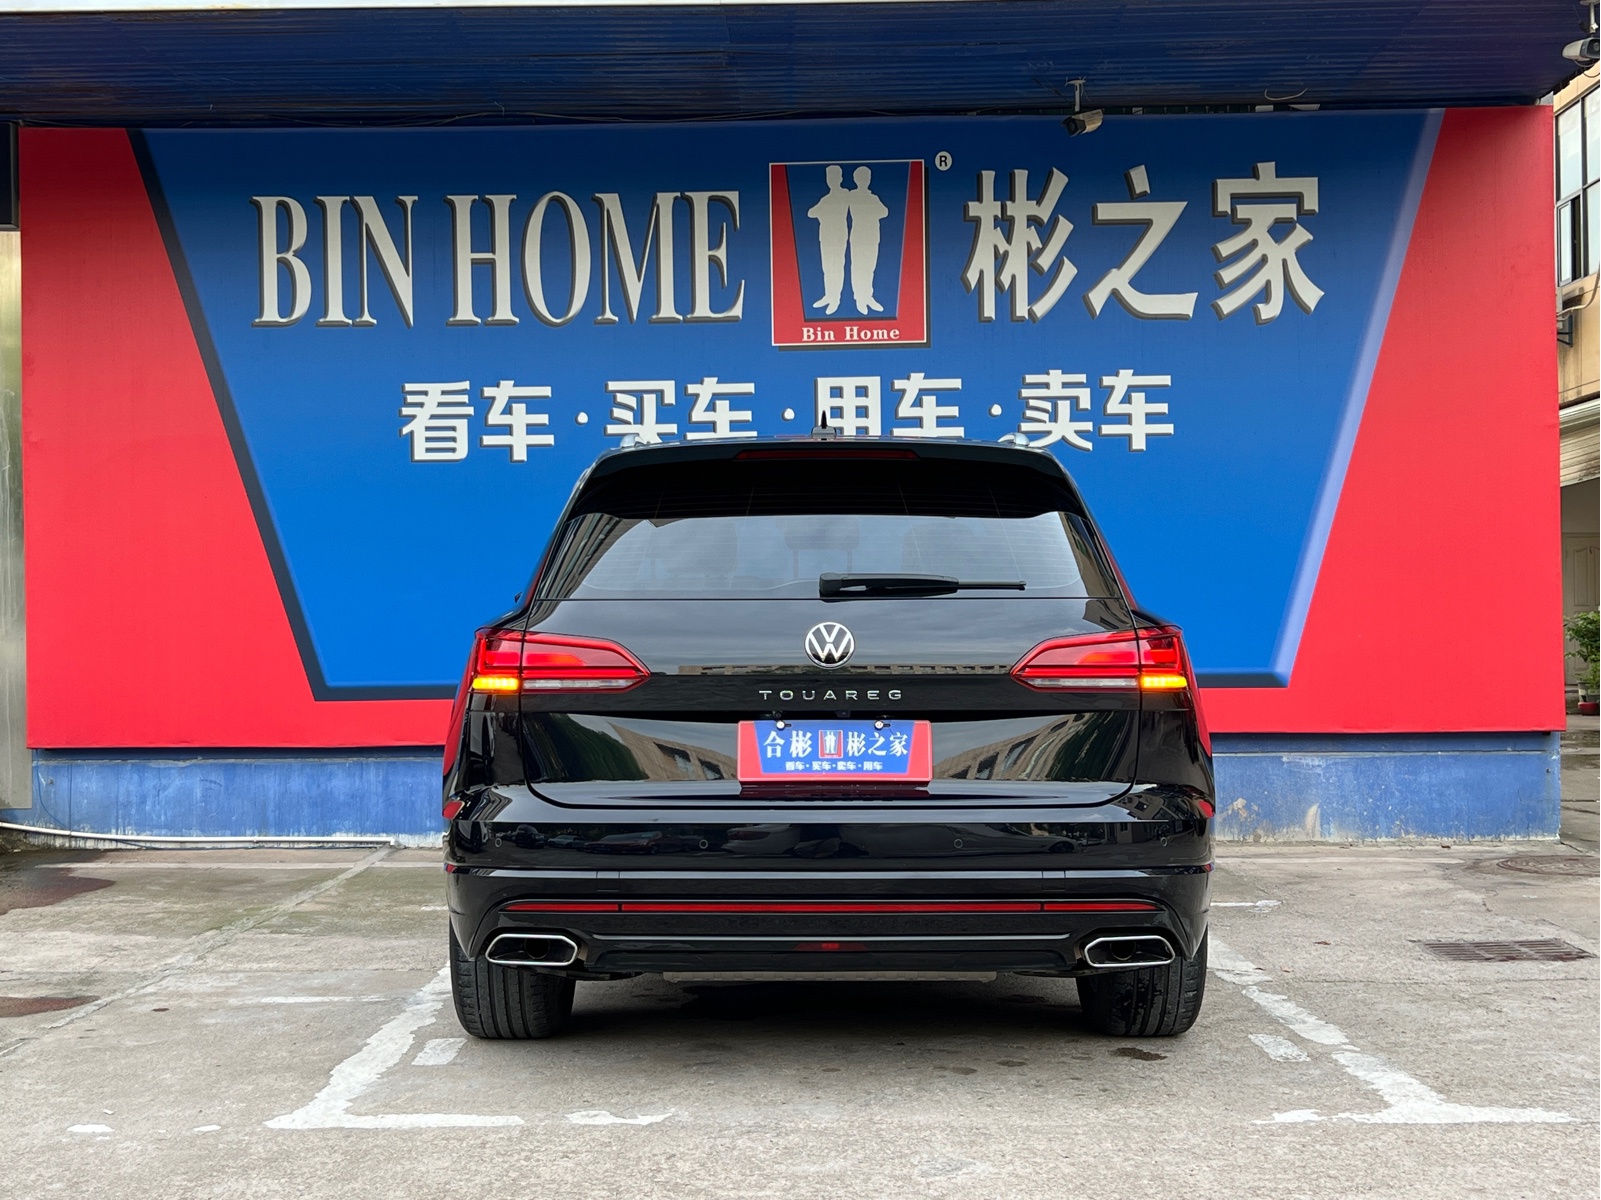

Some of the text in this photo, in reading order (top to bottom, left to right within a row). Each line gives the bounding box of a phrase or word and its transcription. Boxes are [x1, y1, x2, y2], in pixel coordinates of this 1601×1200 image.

[962, 161, 1325, 325] 彬之家
[251, 190, 745, 328] BIN HOME
[801, 326, 900, 342] Bin Home
[758, 690, 902, 700] TOUAREG
[763, 730, 909, 758] 合彬 彬之家
